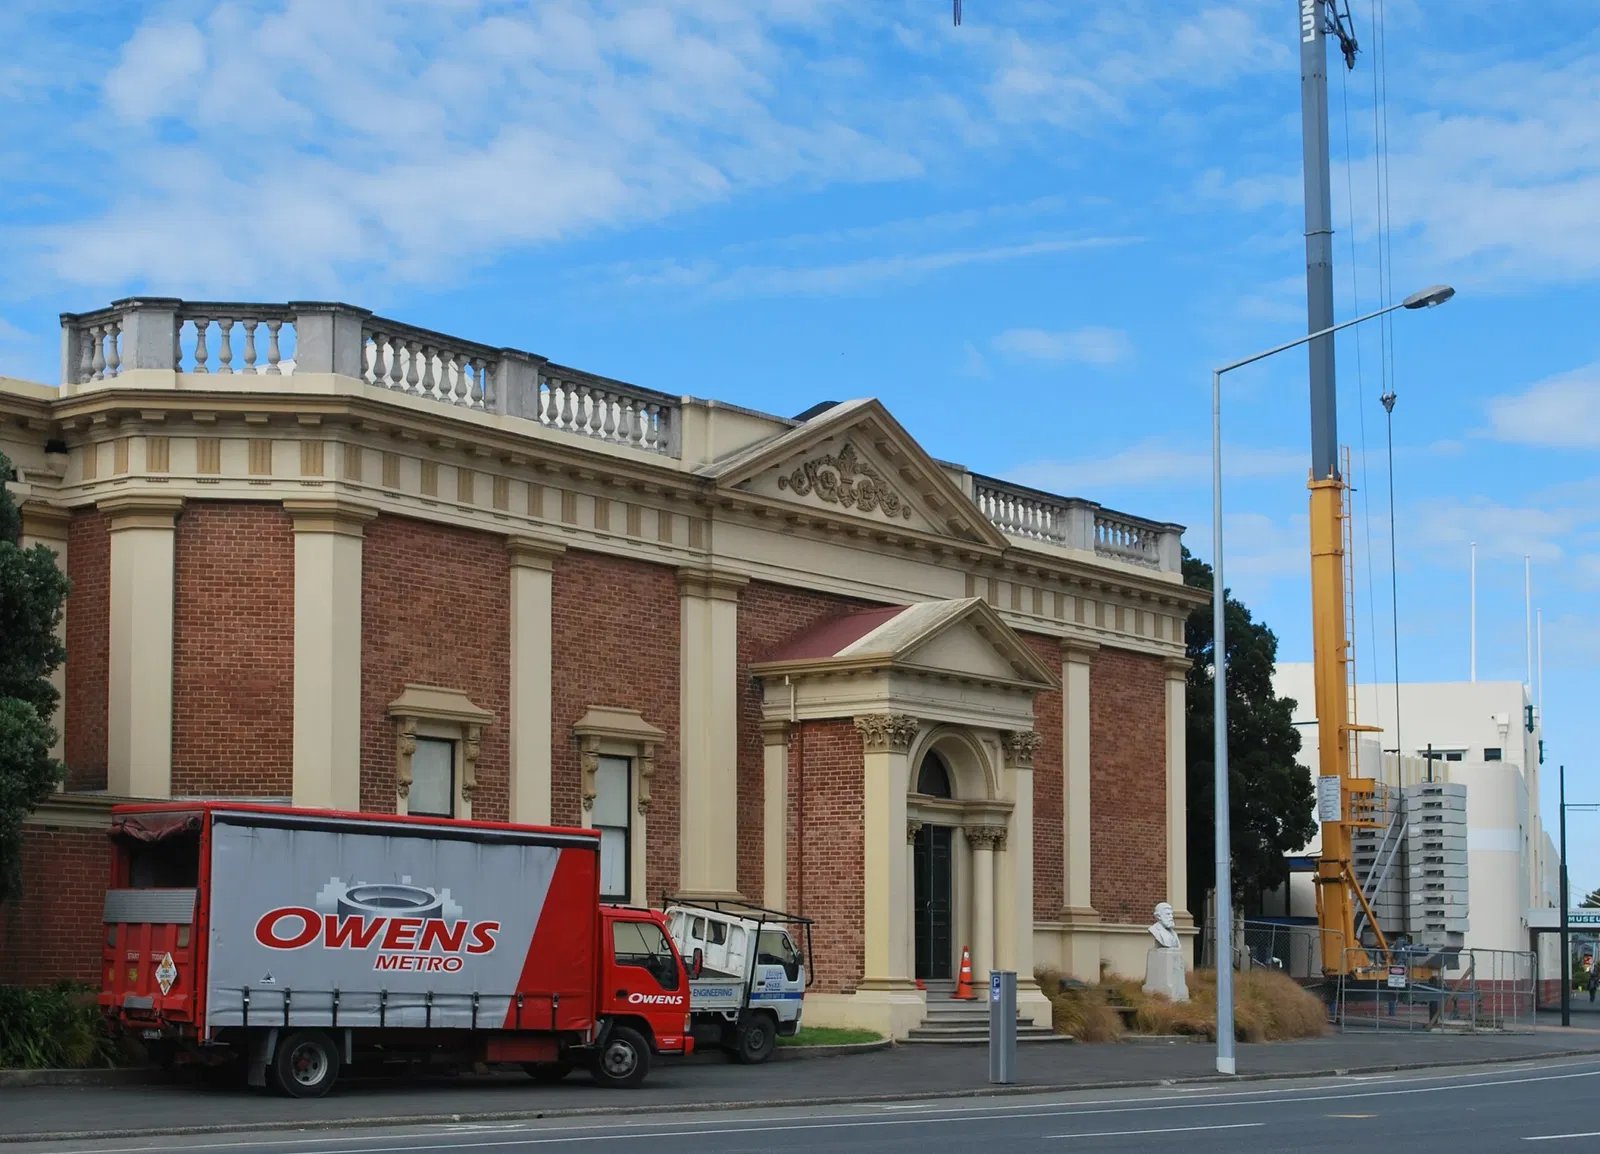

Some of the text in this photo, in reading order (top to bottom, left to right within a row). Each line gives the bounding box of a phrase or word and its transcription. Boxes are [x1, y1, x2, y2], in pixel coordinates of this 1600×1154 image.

[254, 906, 501, 955] OWENS
[373, 954, 464, 973] METRO
[993, 977, 1000, 986] P
[628, 992, 683, 1005] OWENS
[693, 988, 733, 997] ENGINEERING
